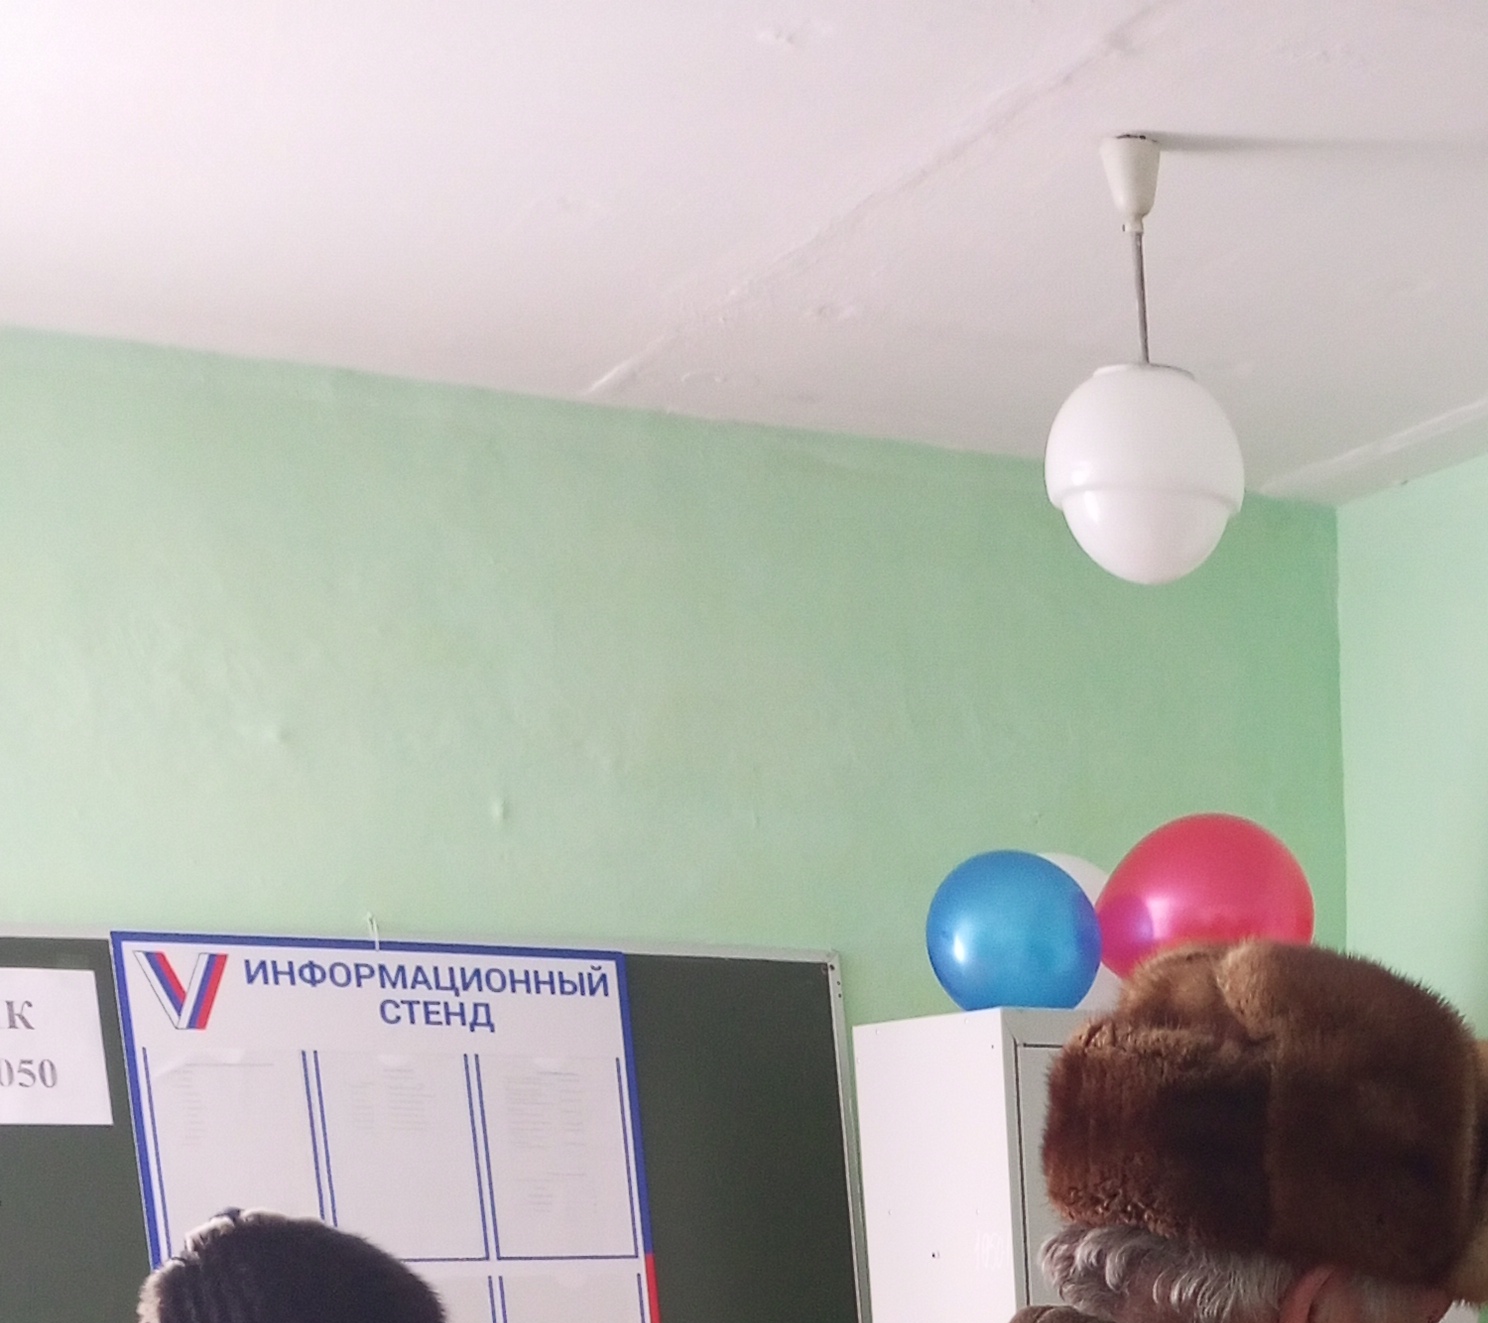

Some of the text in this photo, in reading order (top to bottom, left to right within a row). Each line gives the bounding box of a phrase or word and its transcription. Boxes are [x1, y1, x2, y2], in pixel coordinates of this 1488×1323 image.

[244, 958, 610, 997] ИНФОРМАЦИОННЫЙ
[0, 1000, 35, 1030] К
[379, 999, 495, 1032] СТЕНД
[0, 1058, 58, 1088] 050
